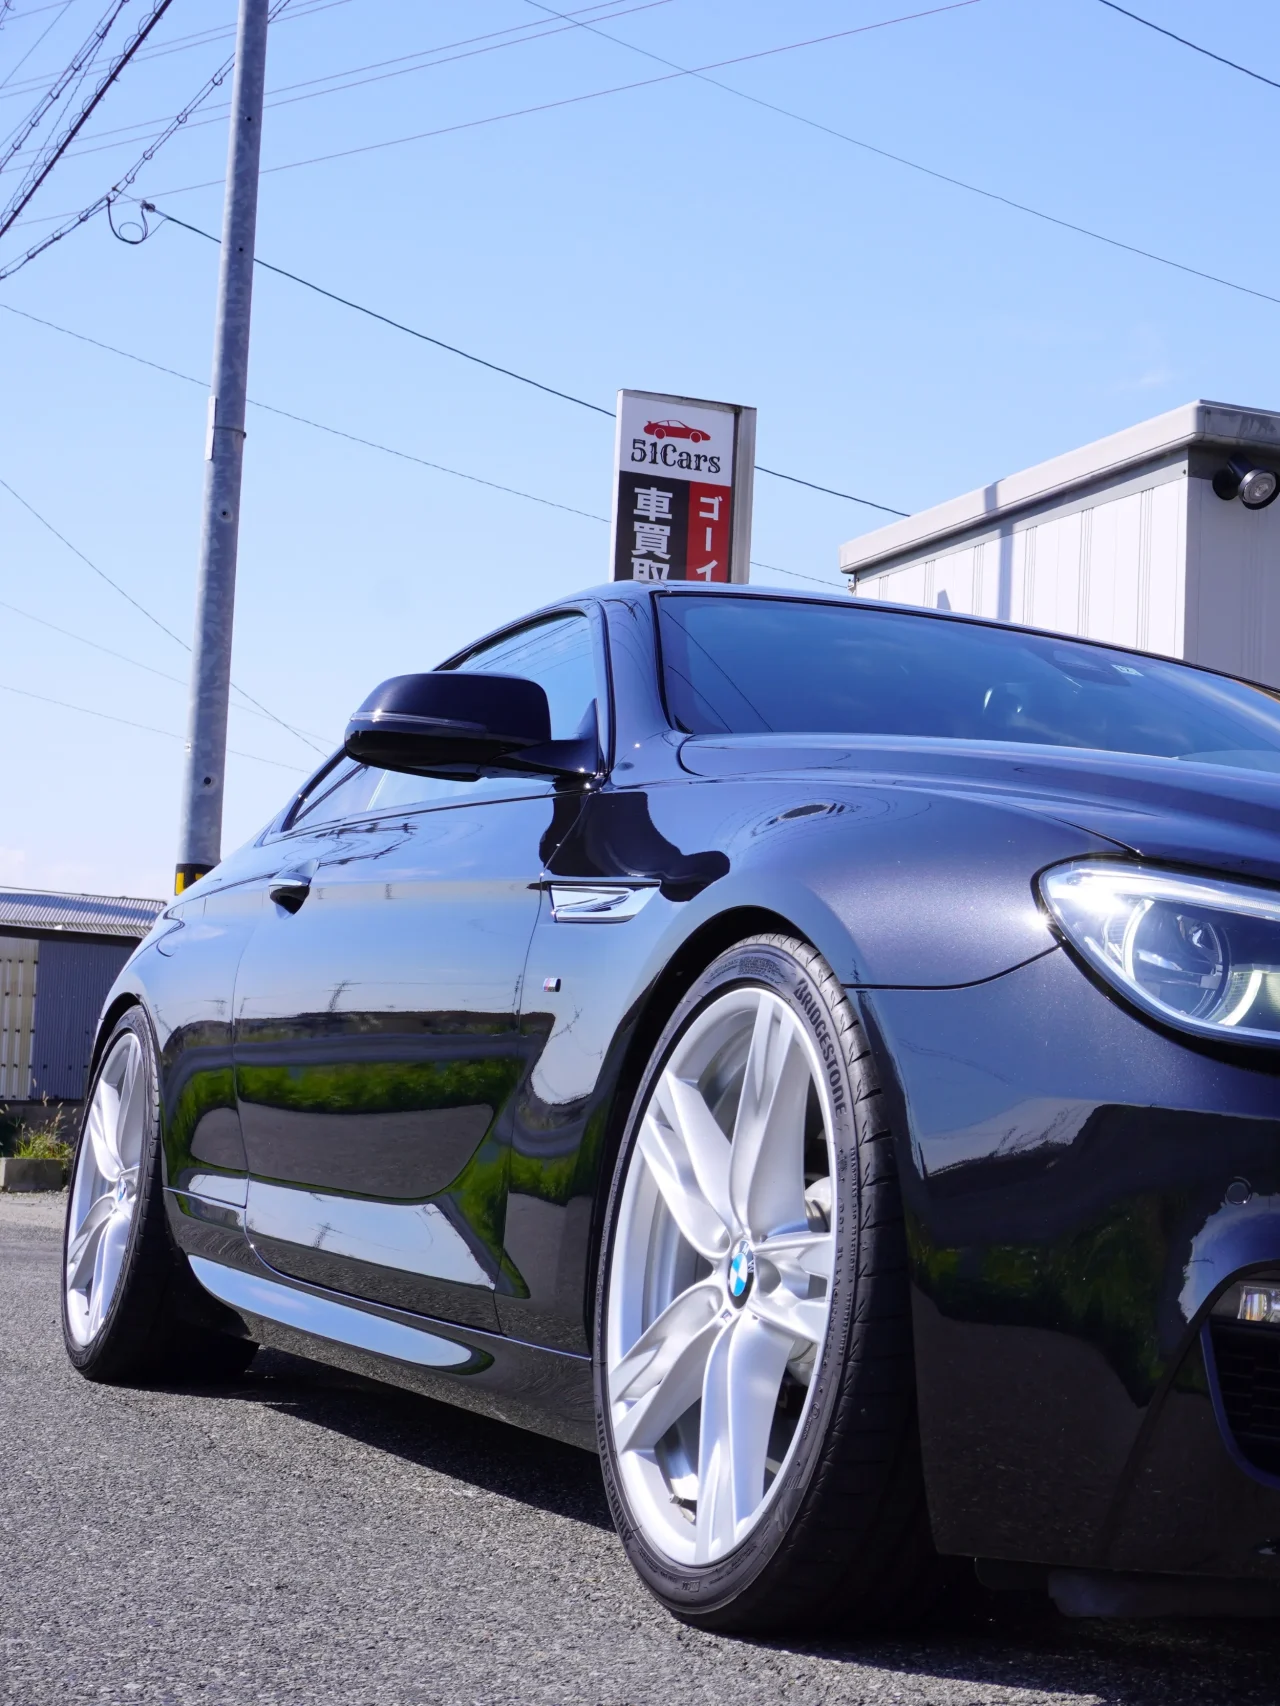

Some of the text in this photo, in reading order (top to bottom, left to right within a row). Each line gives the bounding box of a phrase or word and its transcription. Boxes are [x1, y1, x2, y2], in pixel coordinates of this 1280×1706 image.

[630, 437, 721, 474] 51Cars
[631, 486, 673, 580] 車買取
[793, 976, 848, 1120] BRIDGESTONE
